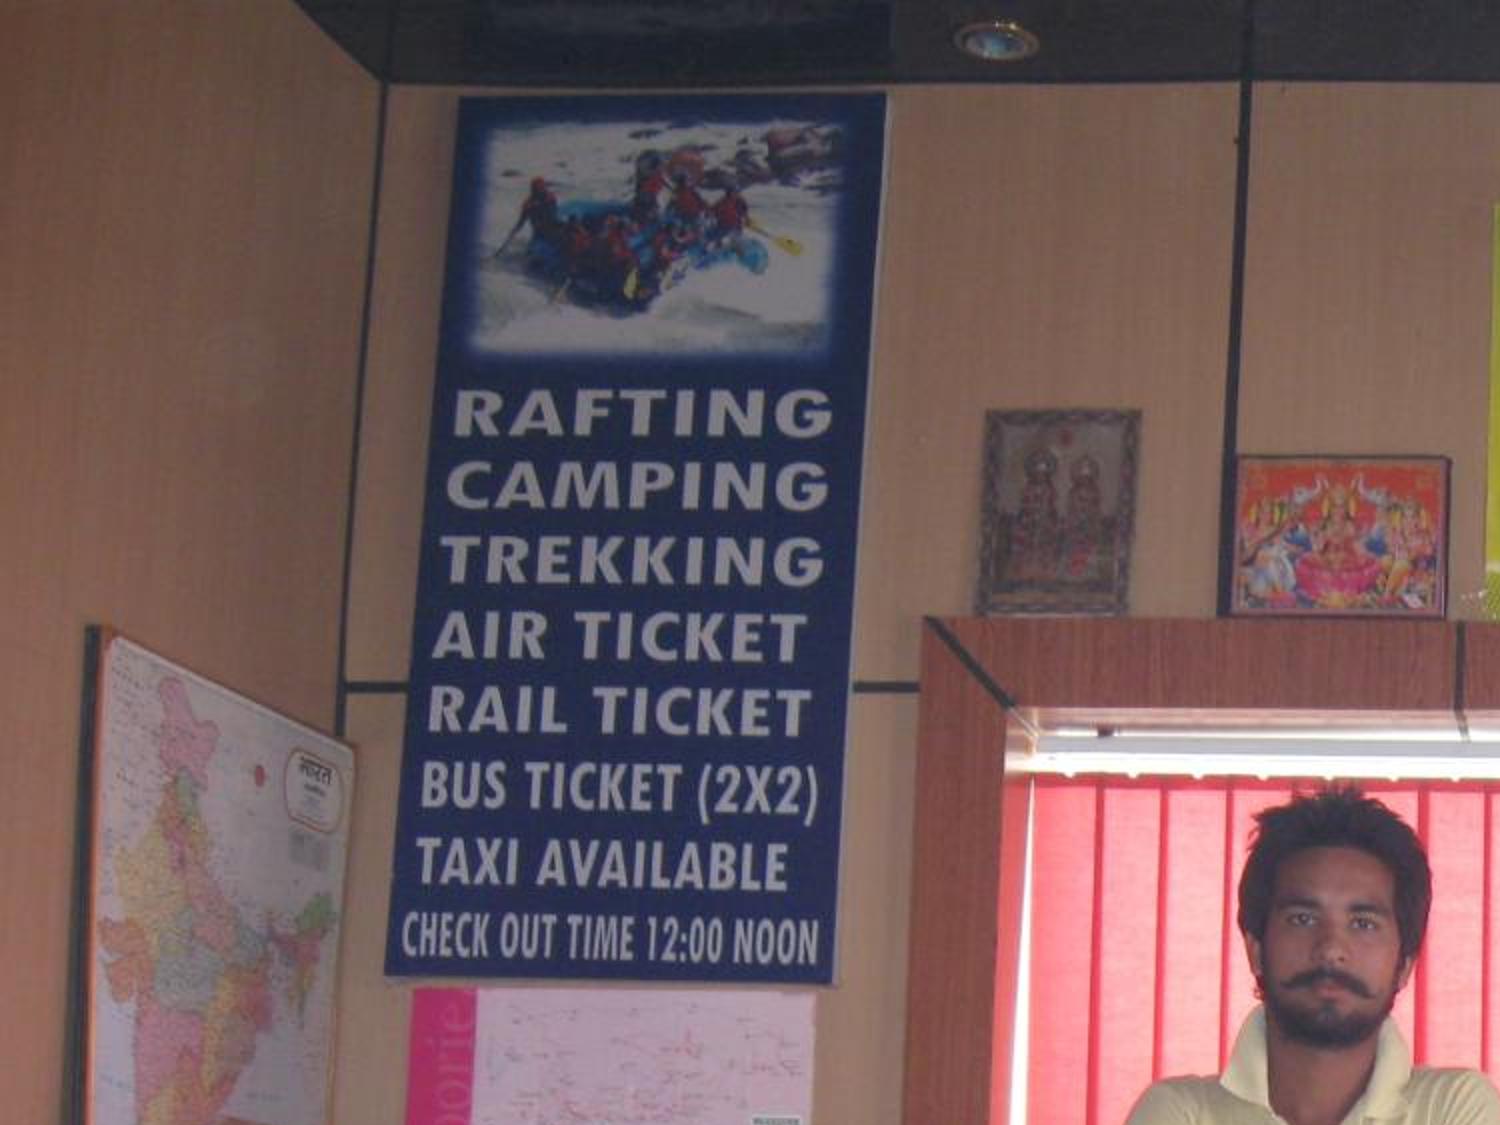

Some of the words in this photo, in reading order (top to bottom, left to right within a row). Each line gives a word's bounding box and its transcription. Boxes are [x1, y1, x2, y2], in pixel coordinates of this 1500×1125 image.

[454, 389, 833, 439] RAFTING
[447, 461, 829, 512] CAMPING
[440, 535, 824, 587] TREKKING
[431, 611, 548, 659] AIR
[574, 611, 808, 663] TICKET
[428, 685, 567, 734] RAIL
[592, 686, 812, 738] TICKET
[421, 760, 506, 809] BUS
[524, 761, 683, 812] TICKET
[698, 763, 819, 827] (2X2)
[415, 837, 519, 885] TAXI
[536, 839, 788, 892] AVAILABLE
[402, 911, 490, 959] CHECK
[500, 912, 558, 960] OUT
[567, 914, 635, 961] TIME
[648, 916, 723, 964] 12:00
[733, 918, 819, 966] NOON
